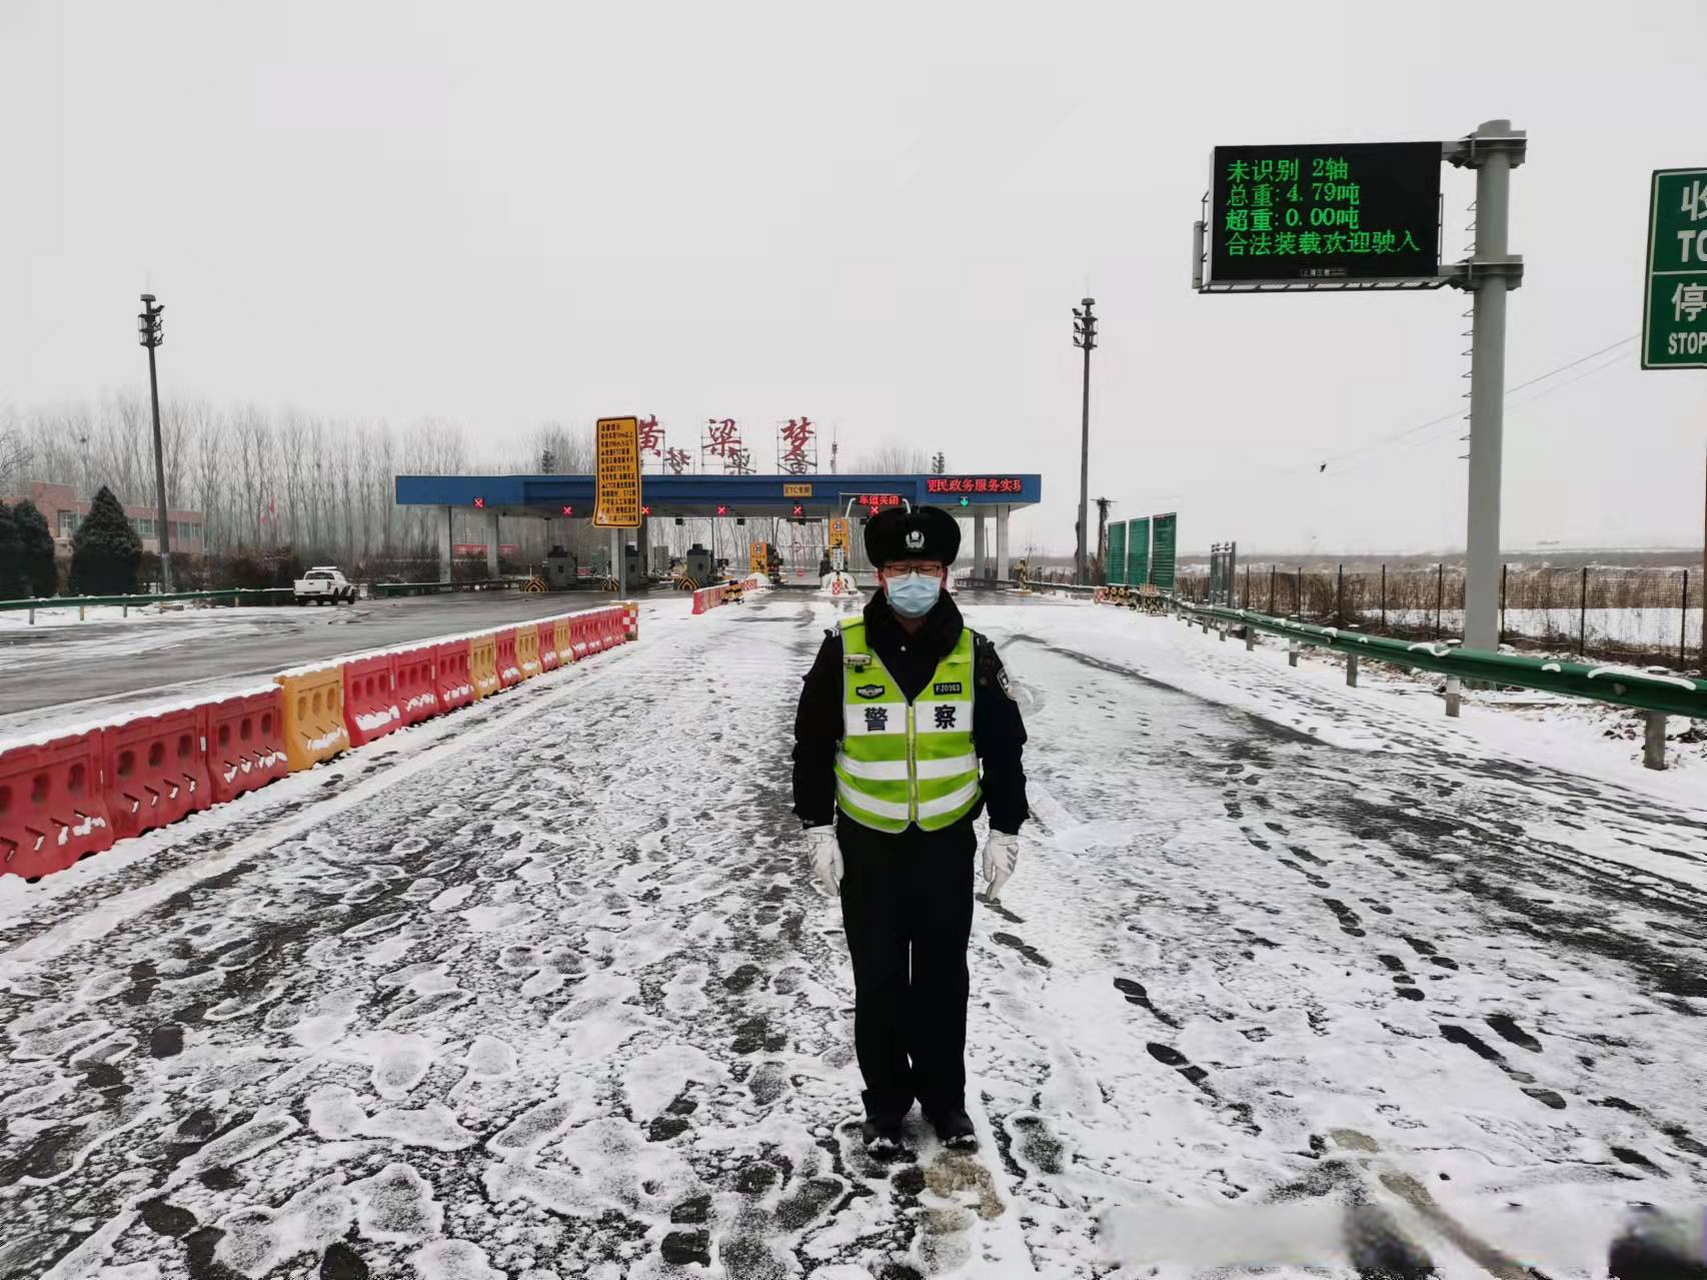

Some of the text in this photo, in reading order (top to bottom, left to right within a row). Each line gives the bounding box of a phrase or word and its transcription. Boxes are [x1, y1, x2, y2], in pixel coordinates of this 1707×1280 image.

[1226, 156, 1349, 182] 未识别 2轴
[1225, 230, 1421, 256] 合法装载欢迎驶入
[1671, 282, 1707, 322] 停
[1668, 332, 1707, 355] STOP
